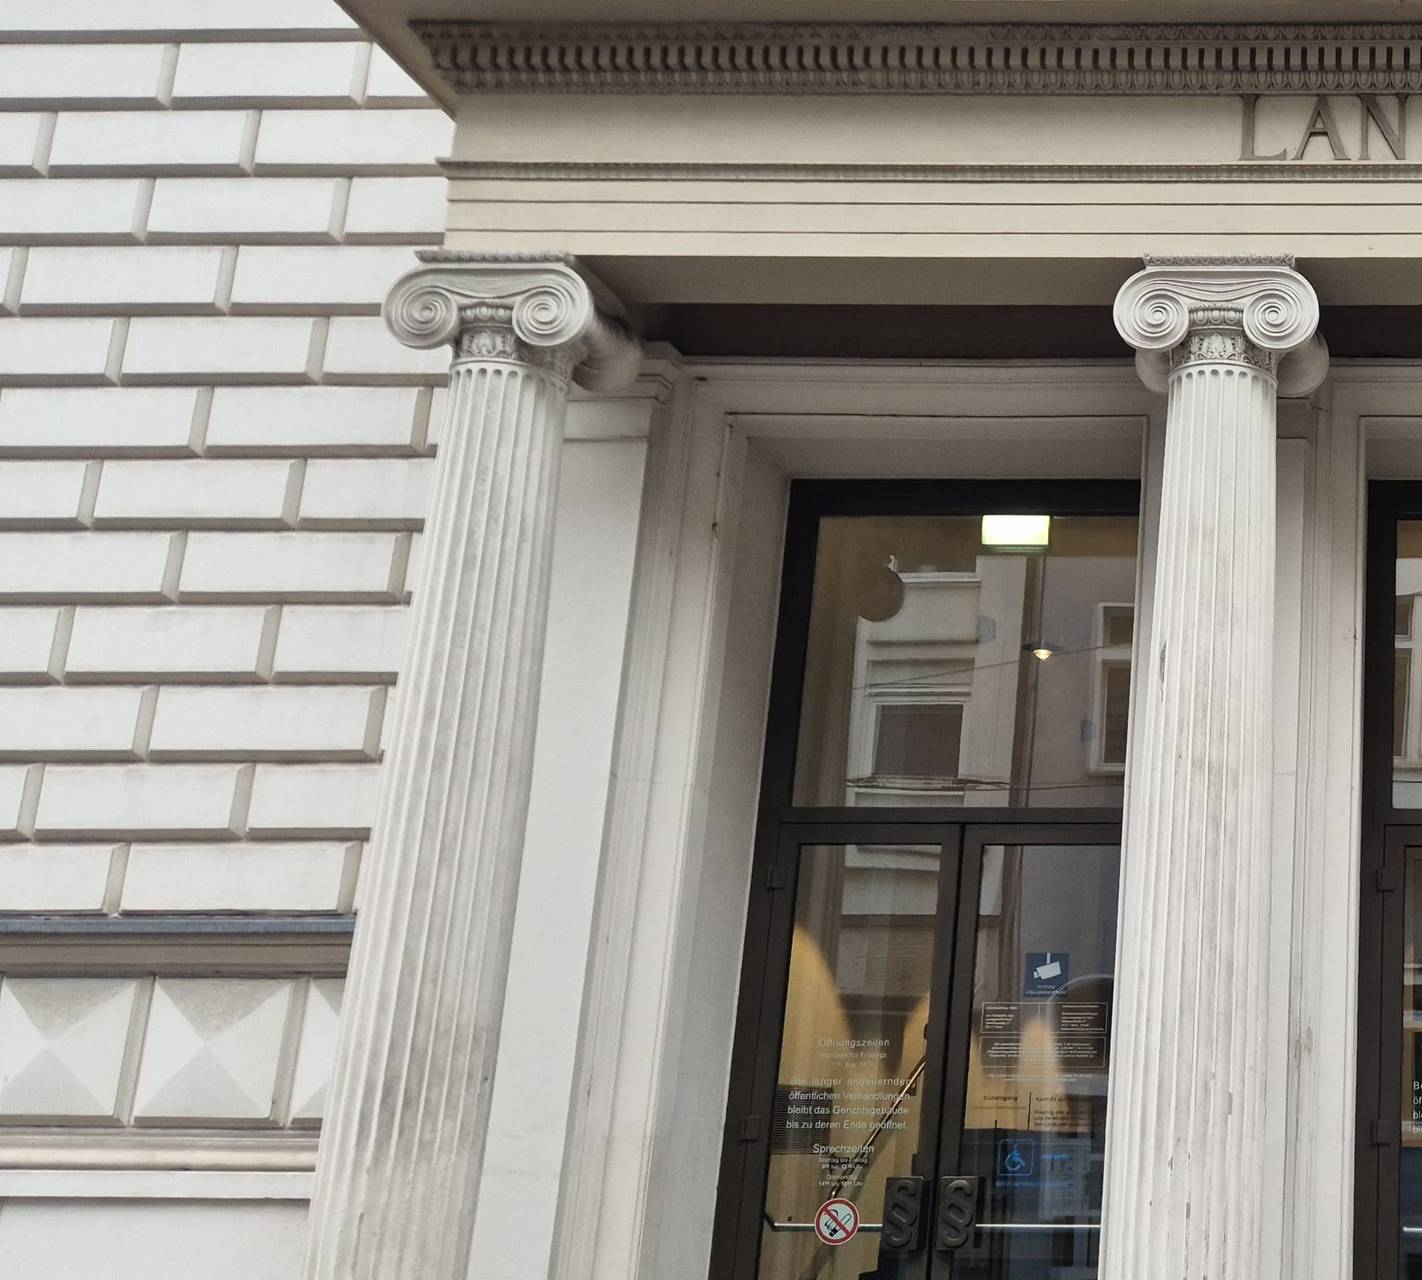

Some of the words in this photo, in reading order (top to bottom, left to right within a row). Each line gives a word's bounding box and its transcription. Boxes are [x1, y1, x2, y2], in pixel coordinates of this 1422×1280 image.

[813, 1105, 830, 1115] das
[786, 1120, 800, 1129] bis
[815, 1120, 841, 1129] deren
[812, 1143, 875, 1156] Sprechzeiten
